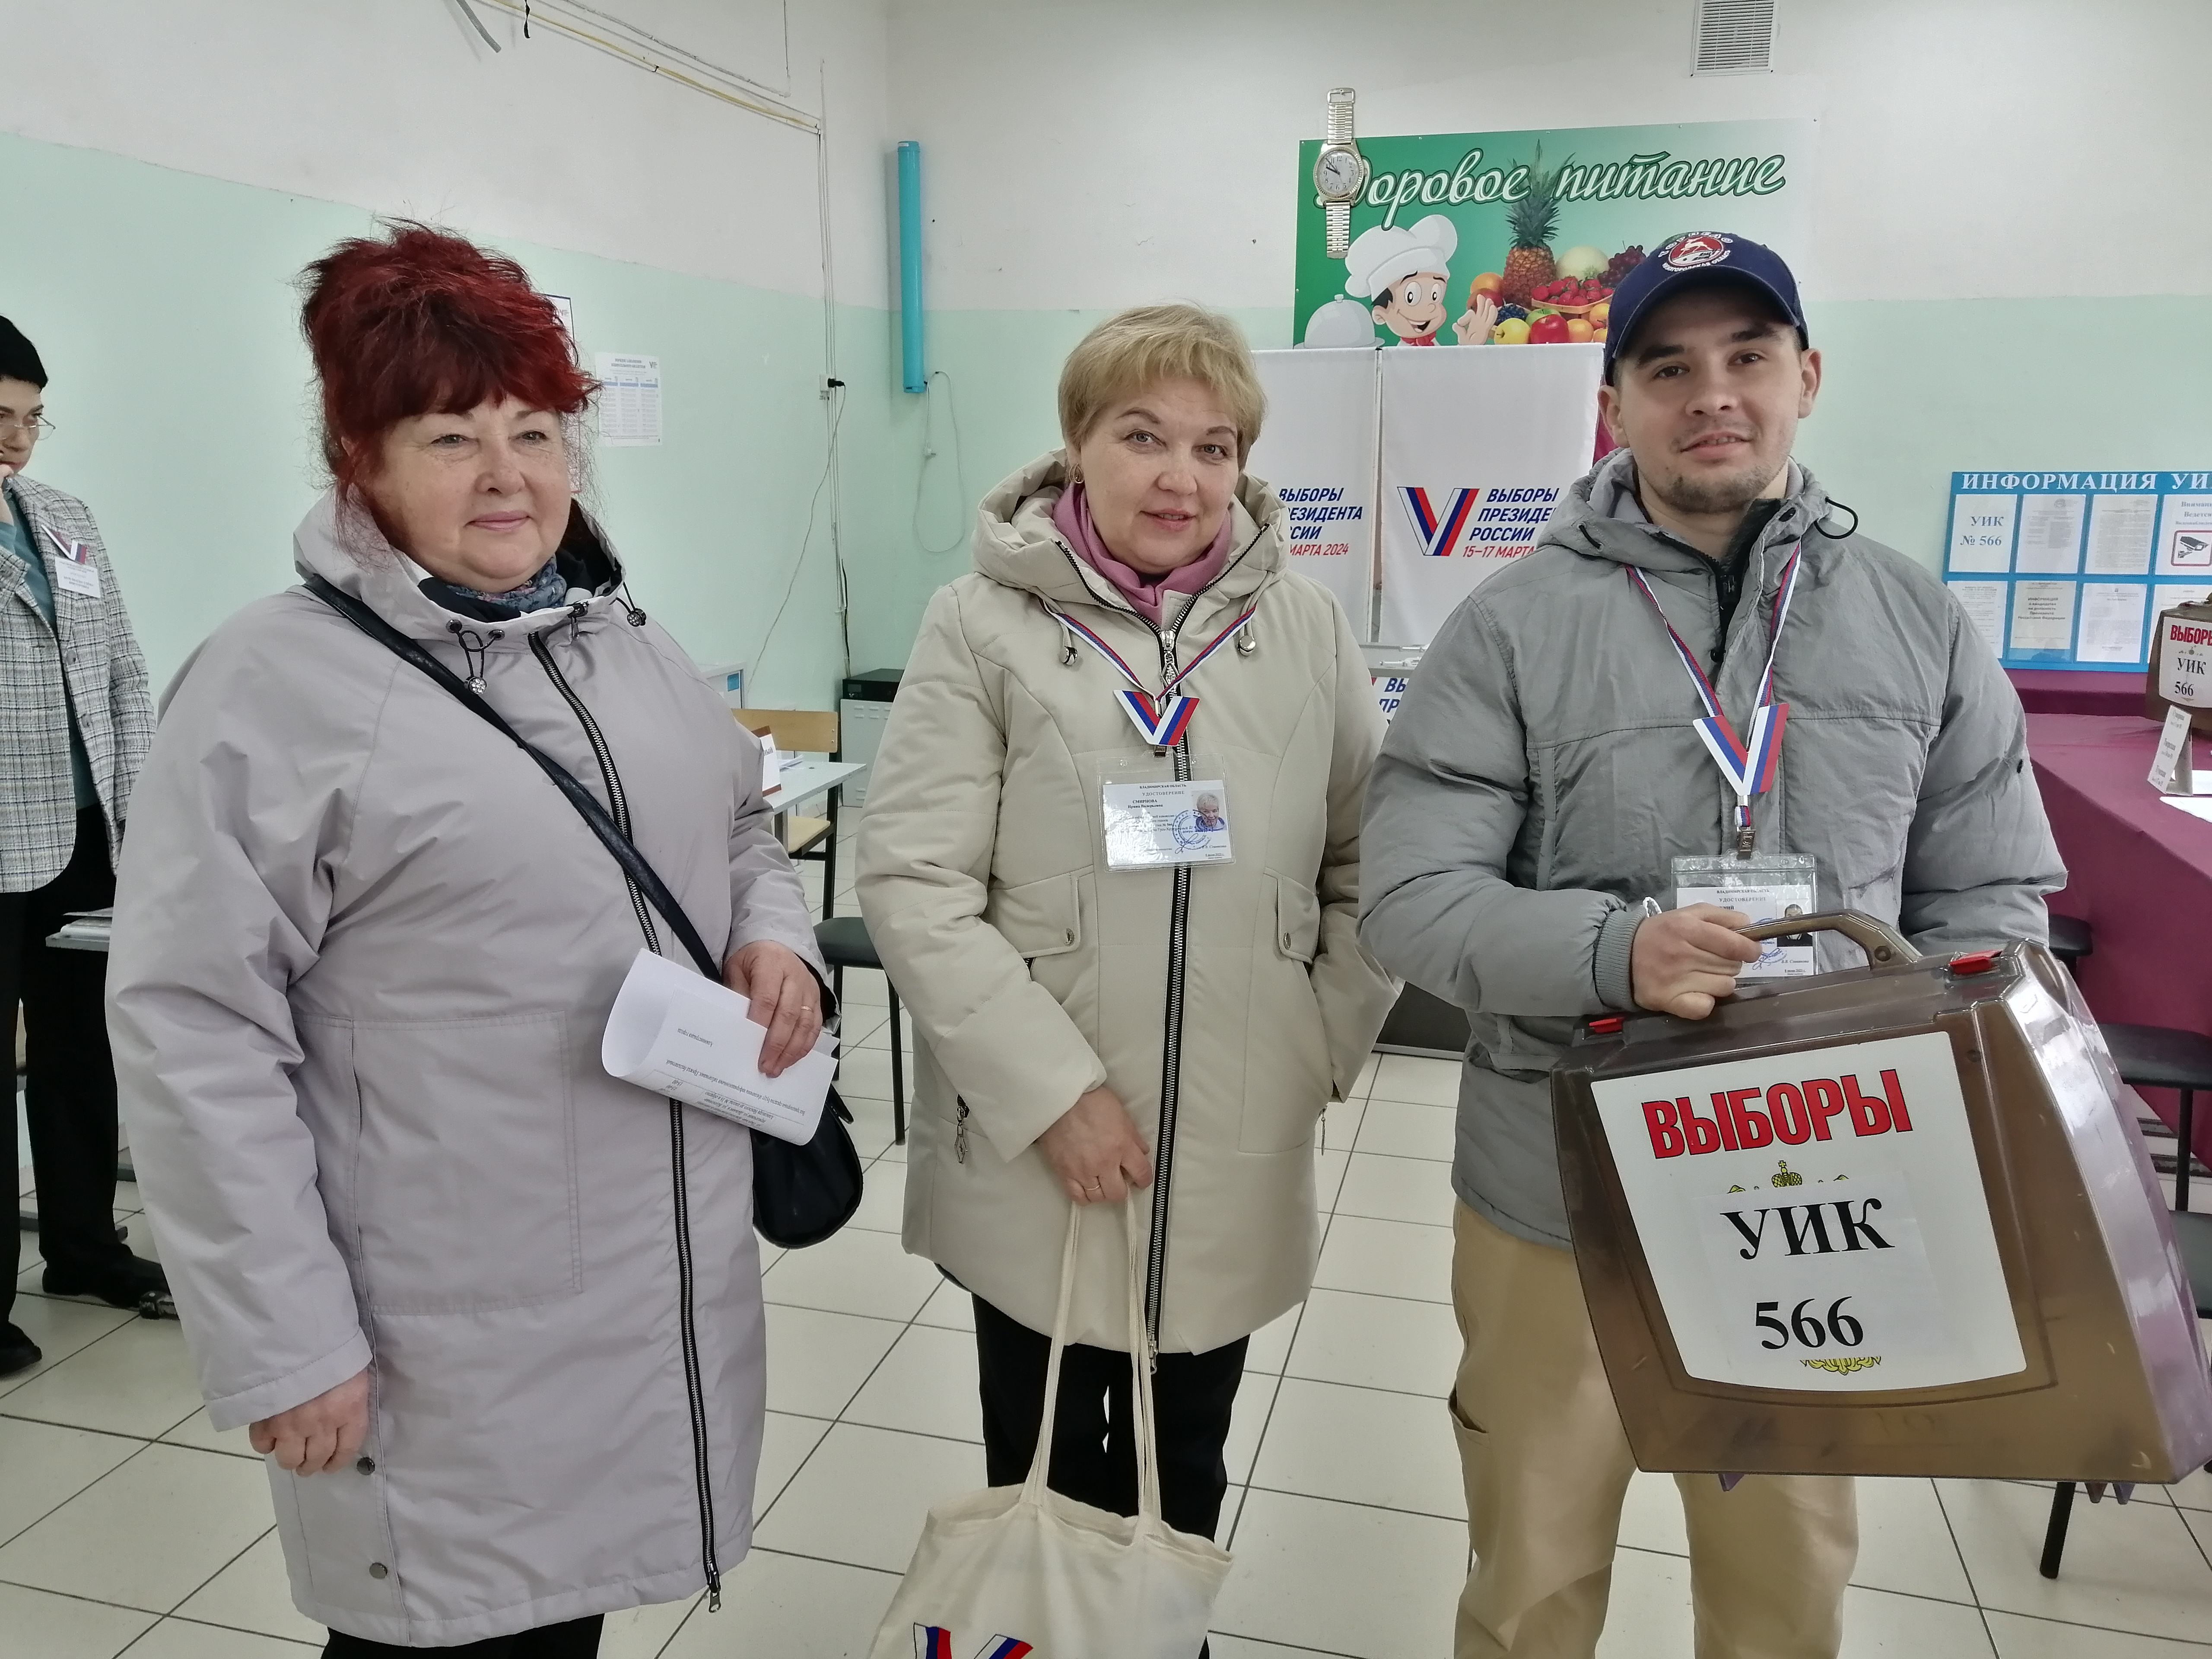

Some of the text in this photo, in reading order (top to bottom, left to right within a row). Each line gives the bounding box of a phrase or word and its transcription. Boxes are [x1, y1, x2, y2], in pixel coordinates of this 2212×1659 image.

[1314, 147, 1786, 230] оровое питание
[1961, 473, 2212, 493] ИНФОРМАЦИЯ УИ
[1279, 487, 1344, 502] ВЫБОРЫ
[1487, 488, 1560, 502] ВЫБОРЫ
[1288, 506, 1363, 522] ЕЗИДЕНТА
[1477, 507, 1556, 524] ПРЕЗИДЕ
[1970, 516, 2004, 526] УИК
[1290, 526, 1322, 540] СИИ
[1469, 527, 1535, 541] РОССИИ
[1960, 535, 2002, 546] № 566
[1323, 543, 1349, 556] 2024
[2177, 658, 2207, 675] УИК
[2175, 681, 2194, 696] 566
[1641, 1069, 1913, 1159] ВЫБОРЫ
[1719, 1197, 1895, 1260] УИК
[1755, 1296, 1864, 1350] 566
